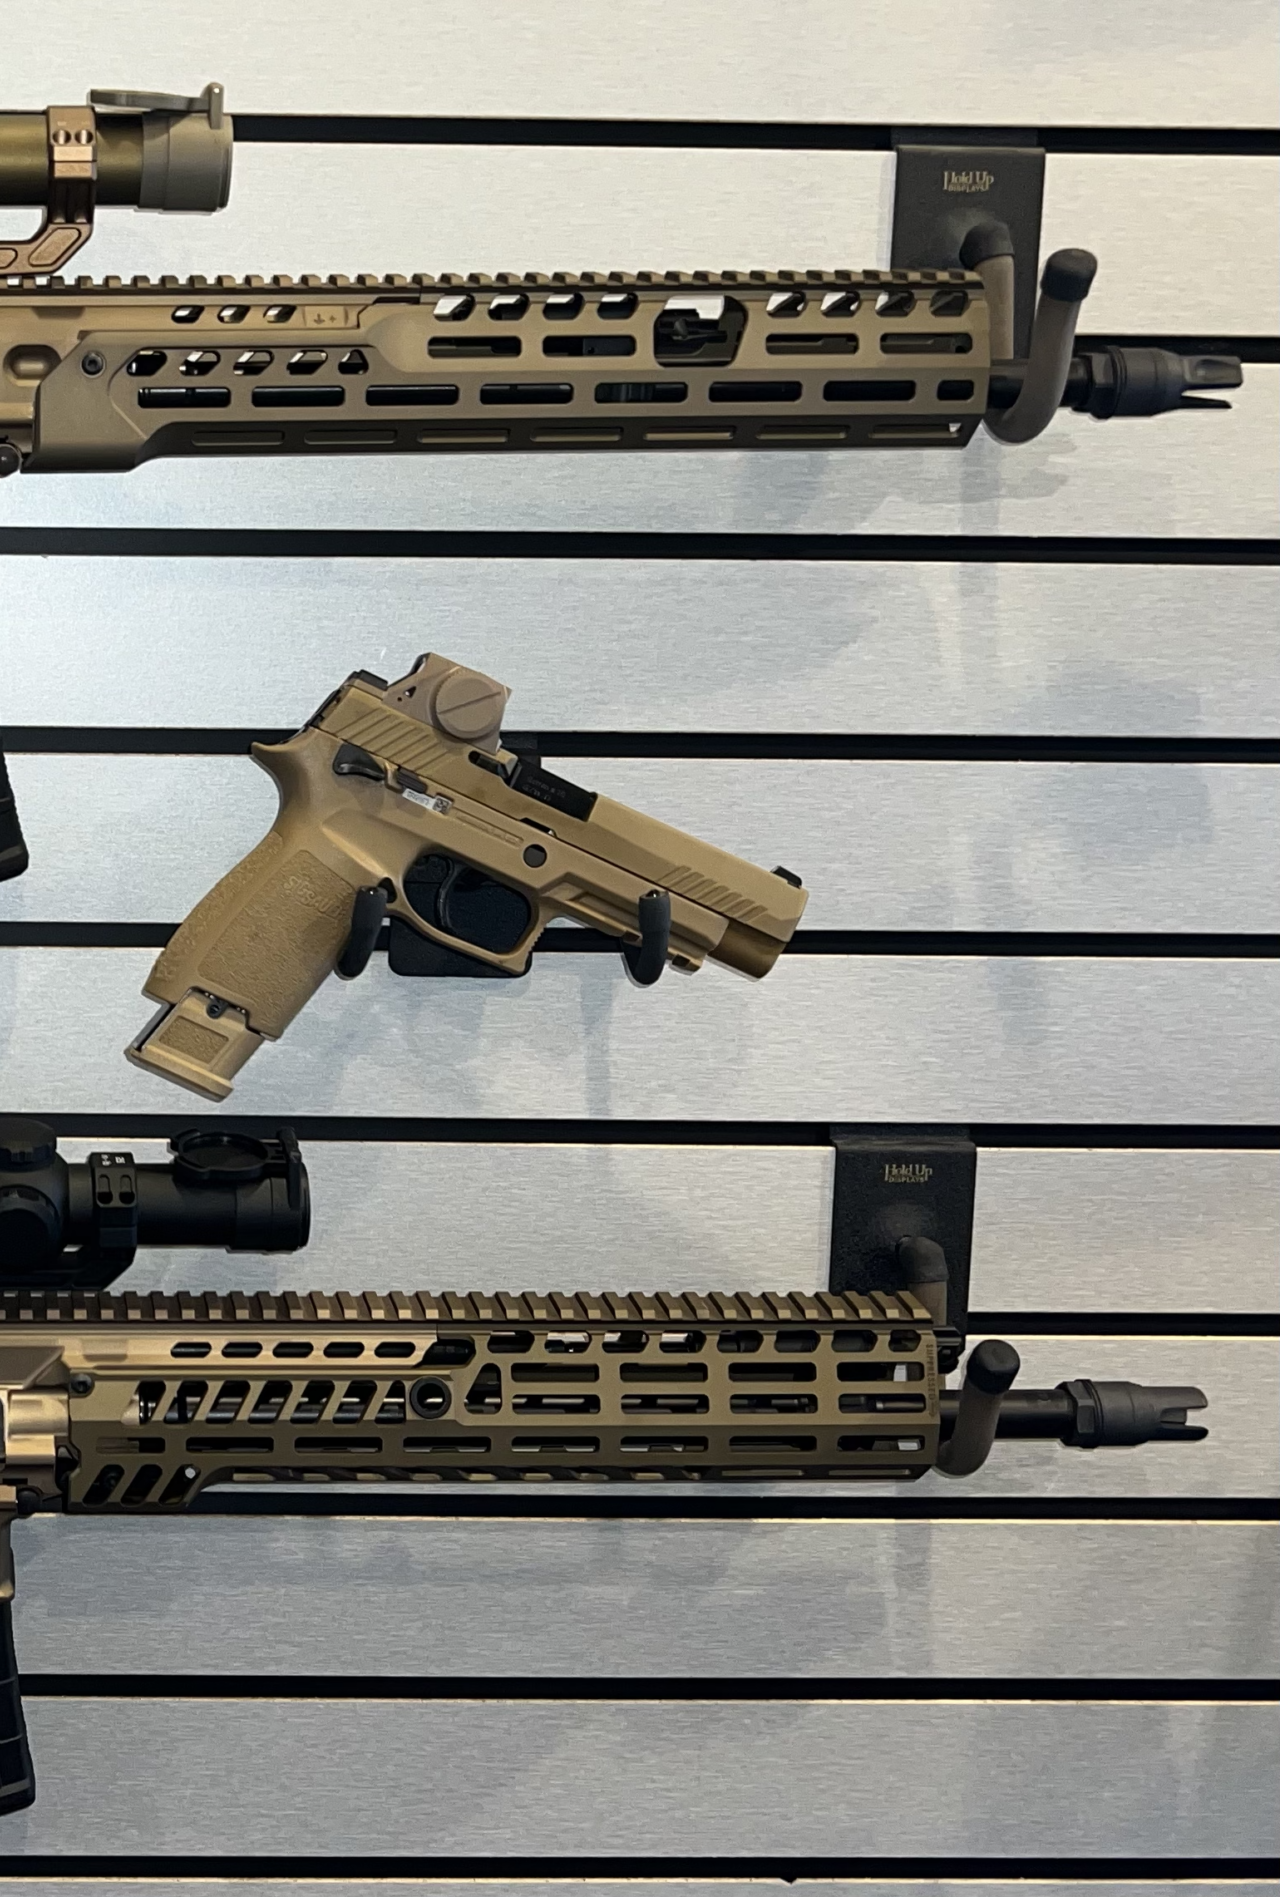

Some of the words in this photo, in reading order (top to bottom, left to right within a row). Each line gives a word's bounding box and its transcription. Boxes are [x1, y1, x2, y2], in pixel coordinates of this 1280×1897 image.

[975, 171, 994, 190] Up
[885, 1164, 913, 1181] Hold
[915, 1164, 932, 1181] Up
[925, 1344, 936, 1400] SUPPRESSED
